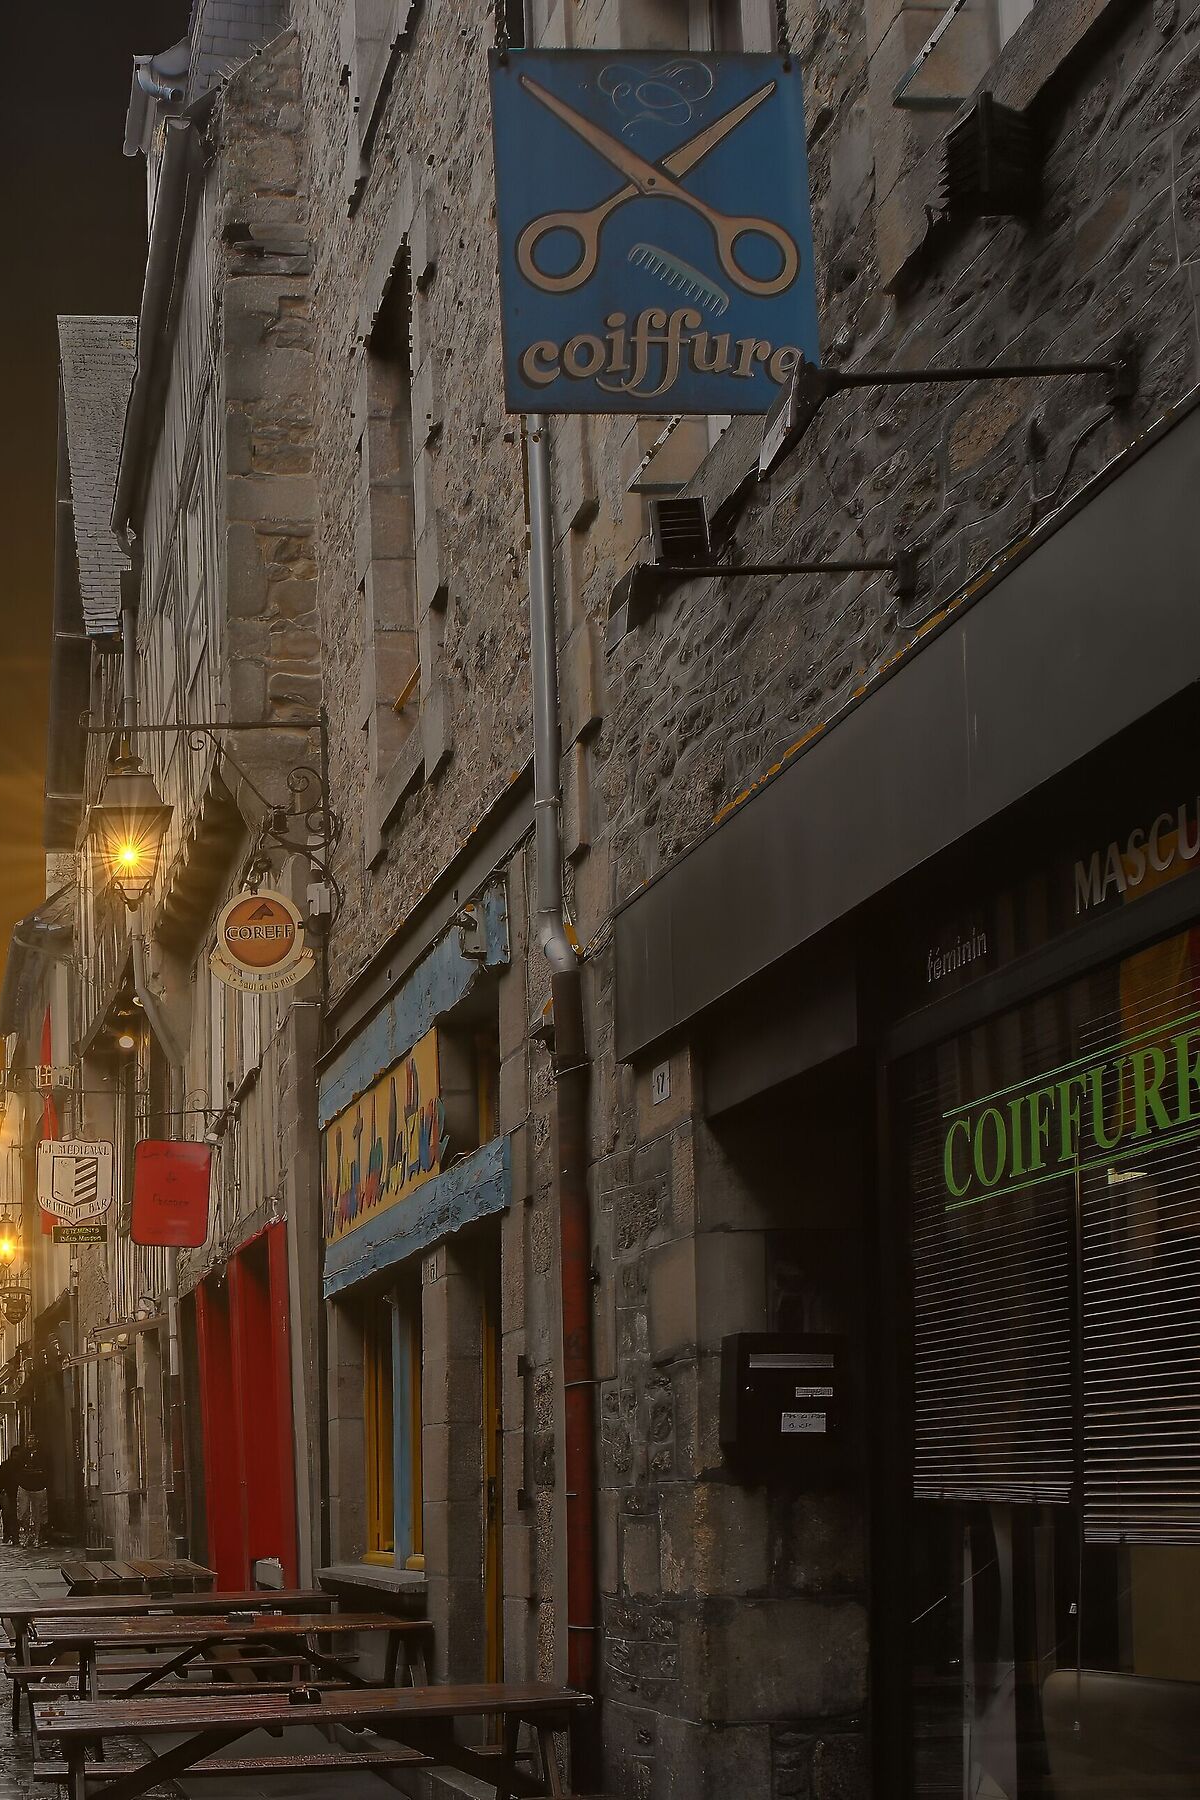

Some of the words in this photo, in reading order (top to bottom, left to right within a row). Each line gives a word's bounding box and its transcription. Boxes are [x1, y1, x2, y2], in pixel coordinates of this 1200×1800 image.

[522, 307, 803, 398] coiffure
[225, 923, 294, 942] COREFF
[927, 927, 988, 983] féminin
[943, 1028, 1200, 1197] COIFFURE
